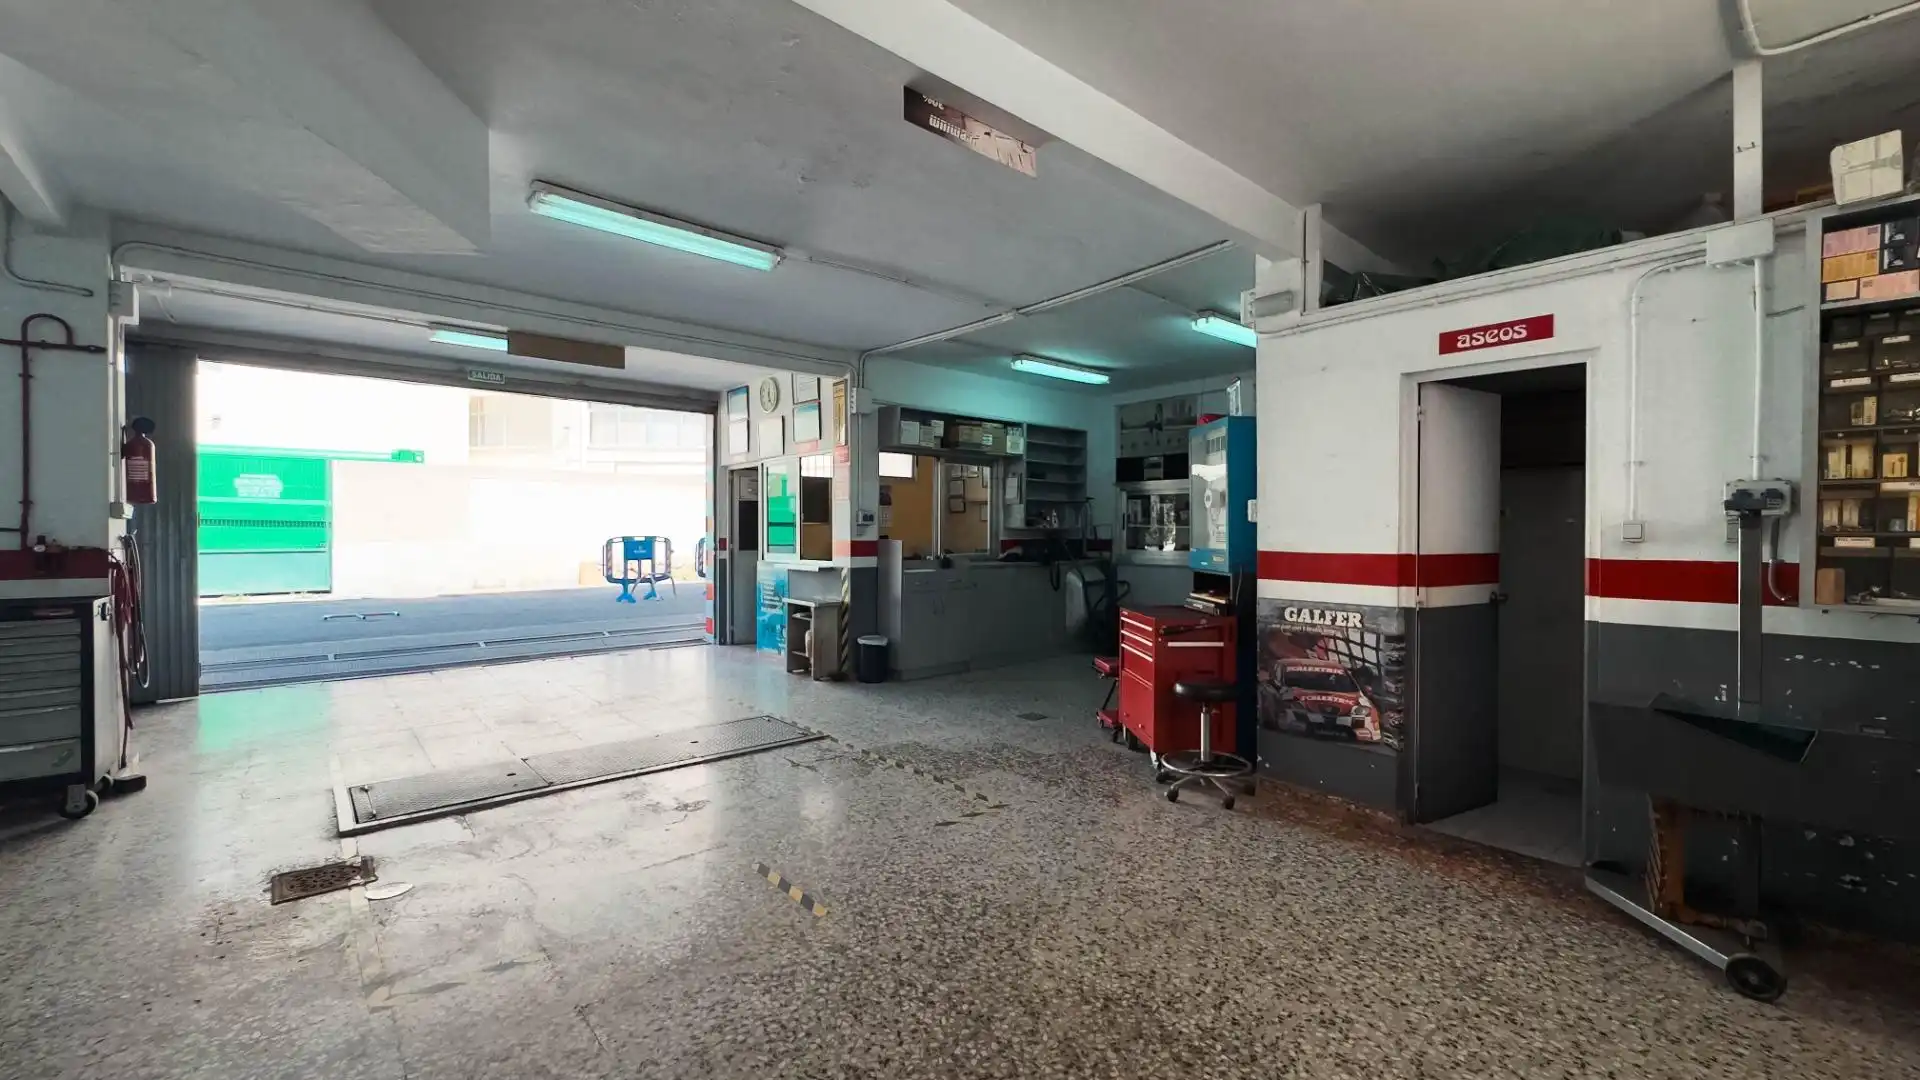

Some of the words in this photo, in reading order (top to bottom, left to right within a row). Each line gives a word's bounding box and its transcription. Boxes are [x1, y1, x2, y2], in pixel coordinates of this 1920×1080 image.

[1456, 324, 1528, 348] aseos
[471, 371, 501, 381] SALIDA
[1284, 606, 1362, 628] GALFER
